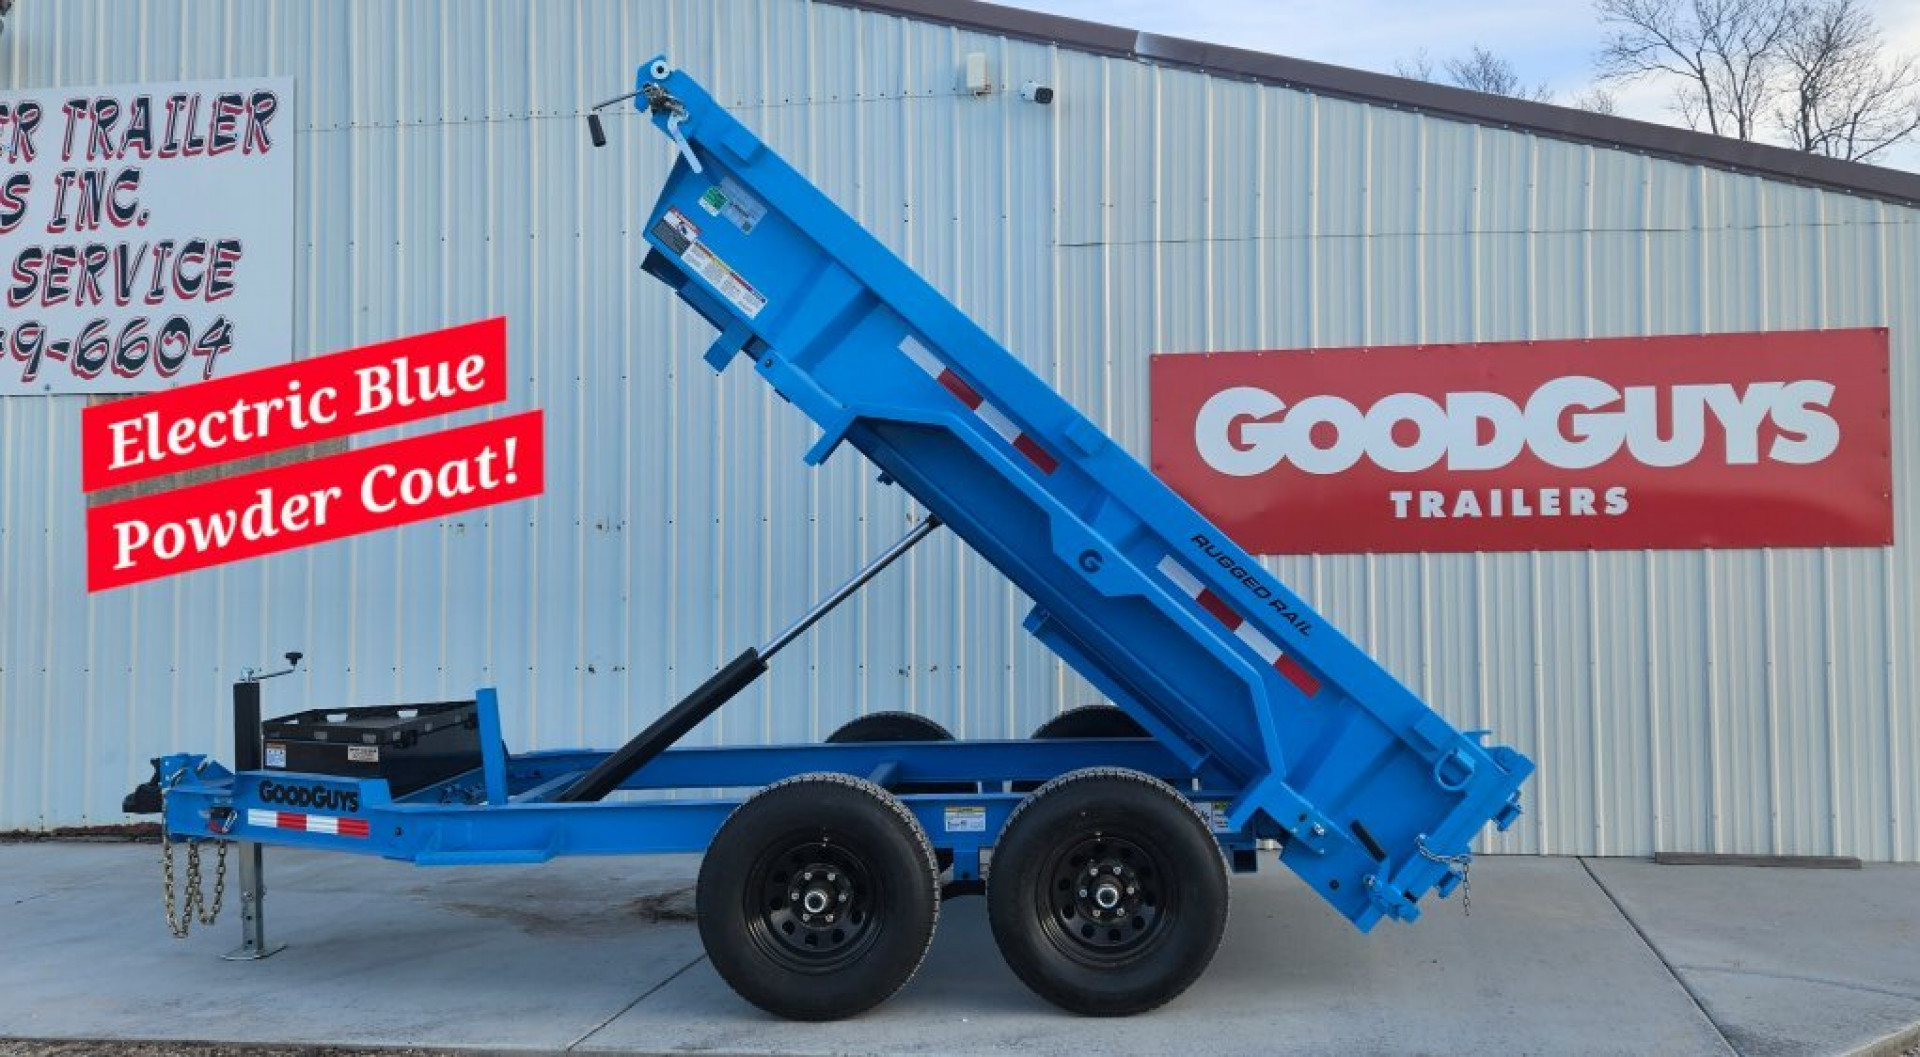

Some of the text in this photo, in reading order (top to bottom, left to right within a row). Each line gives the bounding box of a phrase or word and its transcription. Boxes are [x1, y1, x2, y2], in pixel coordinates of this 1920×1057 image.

[0, 88, 279, 164] R TRAILER
[46, 165, 151, 233] INC.
[7, 237, 243, 307] SERVICE
[0, 313, 234, 382] 9-6604
[1195, 375, 1841, 477] GOODGUYS
[1390, 487, 1629, 519] TRAILERS
[1079, 549, 1103, 573] G
[1191, 534, 1312, 637] RUGGED RAIL
[259, 780, 361, 812] GOODGUYS
